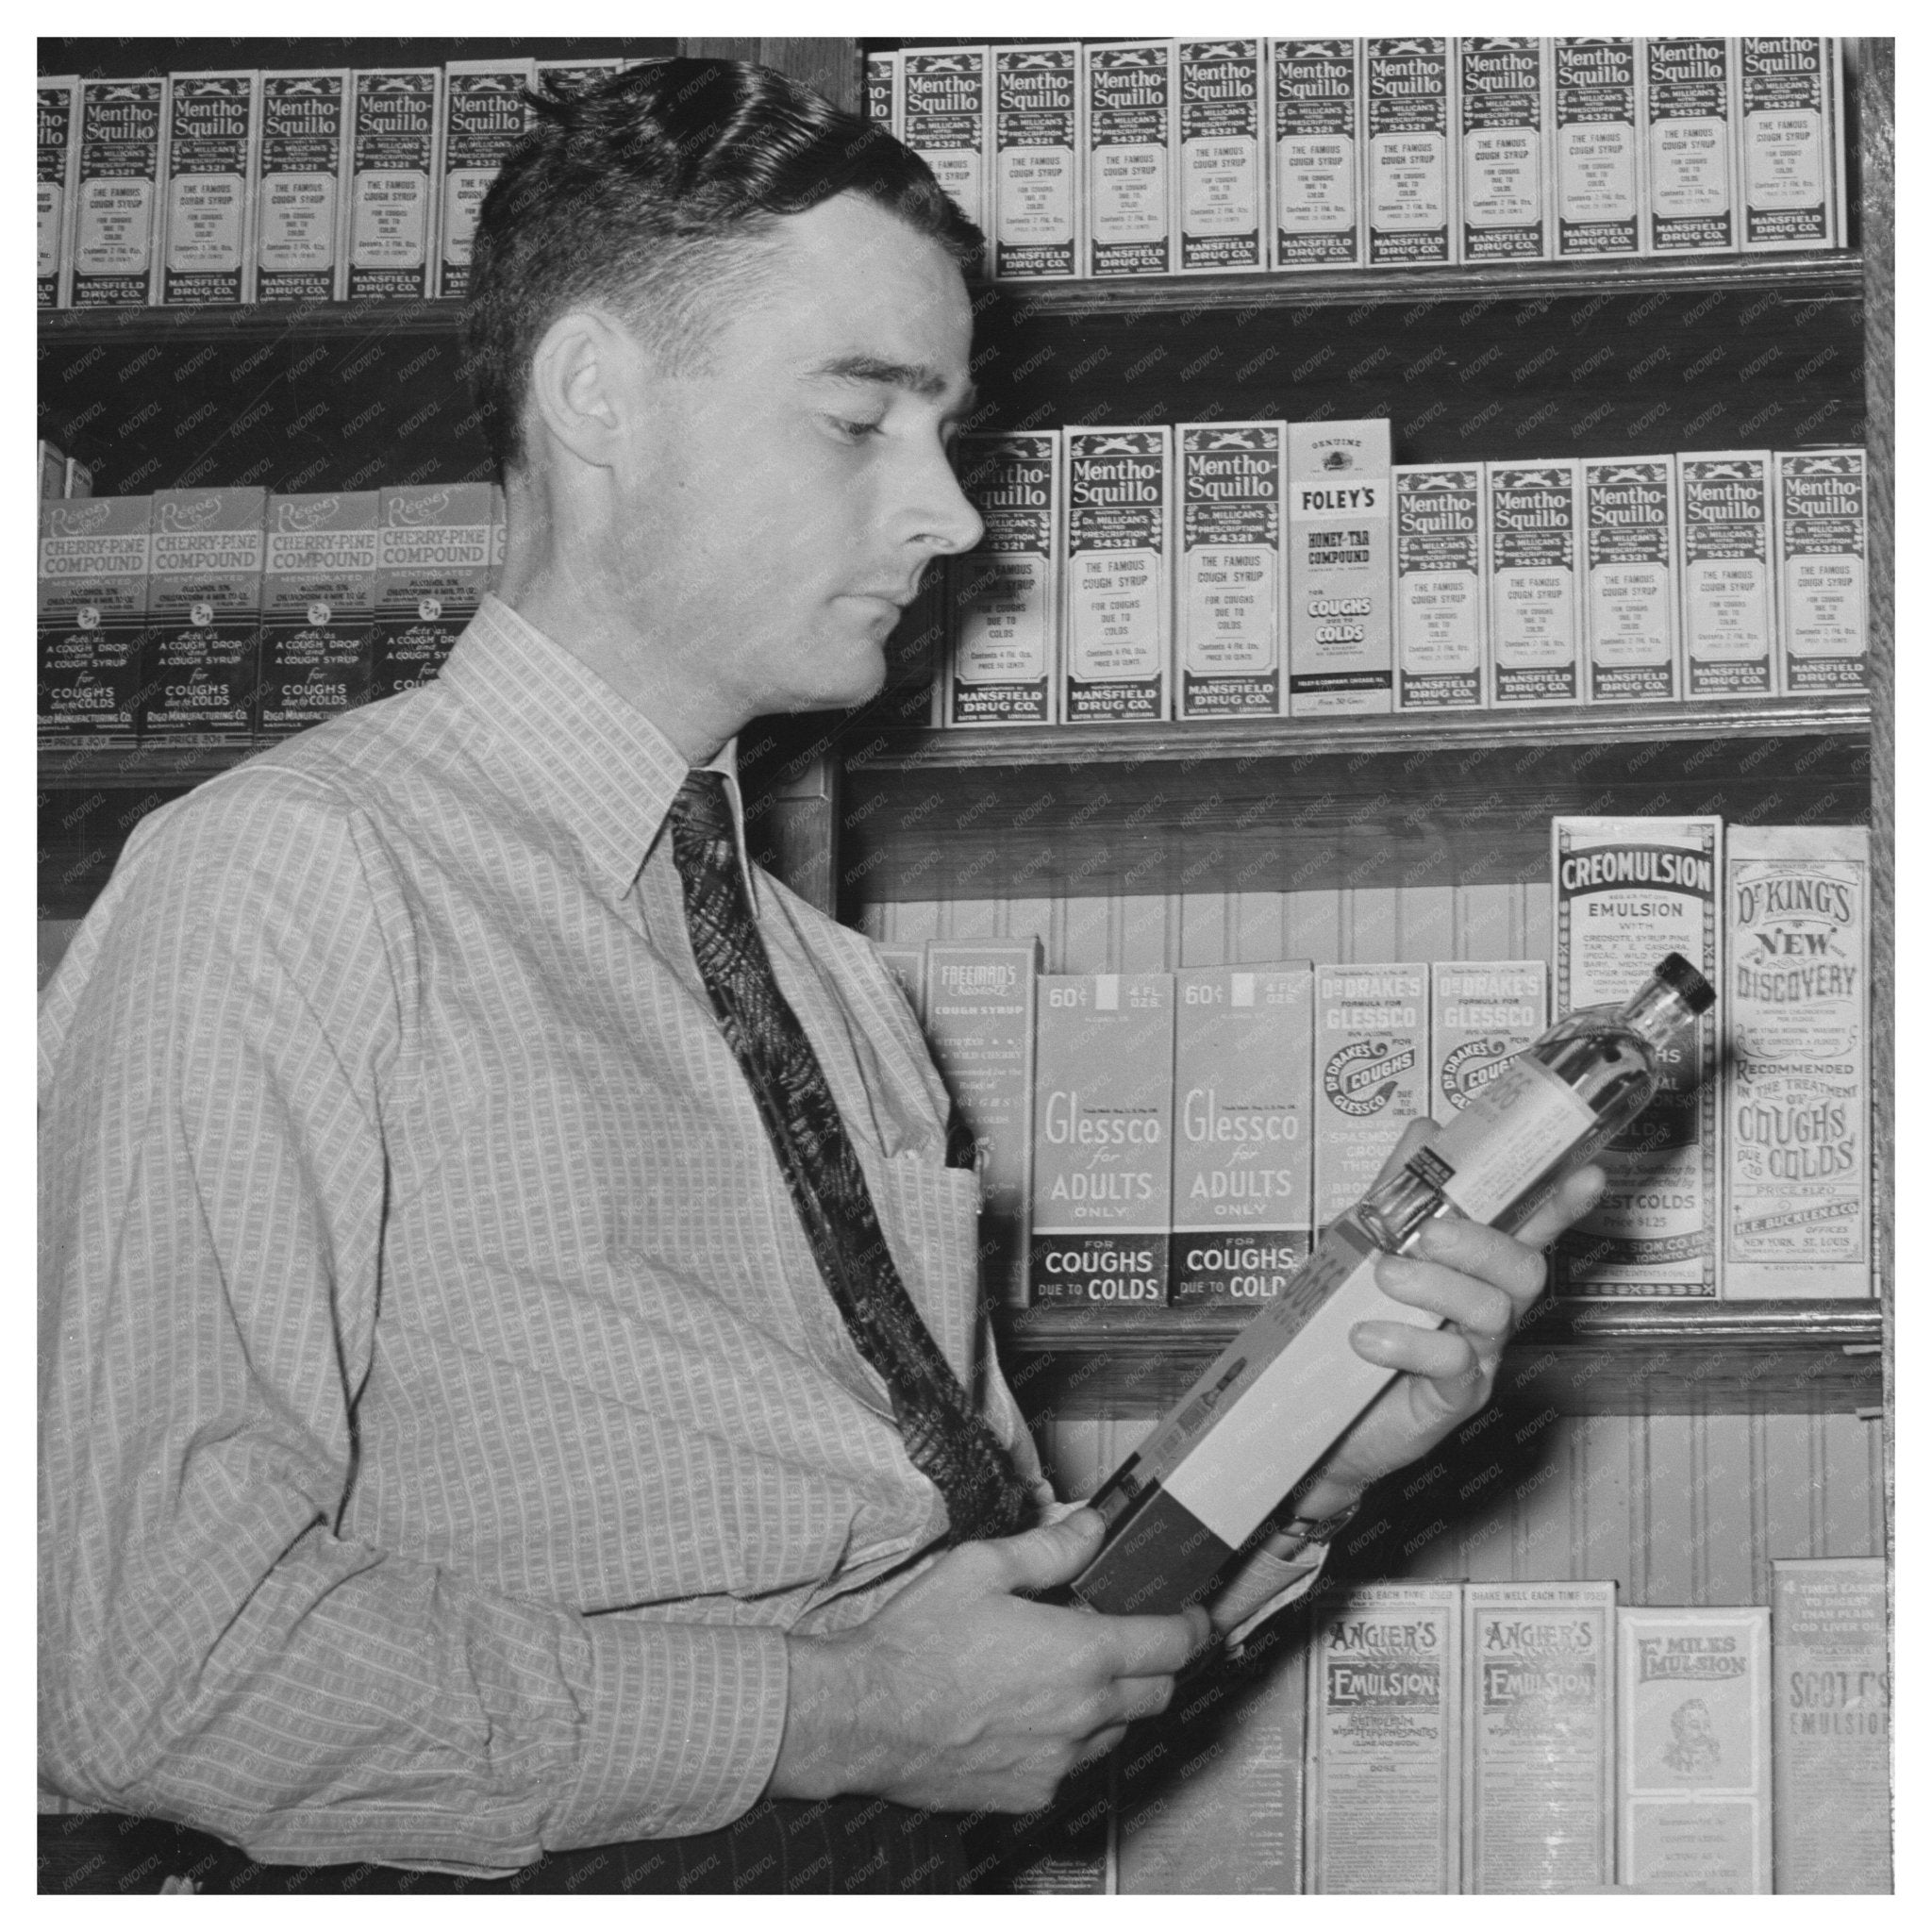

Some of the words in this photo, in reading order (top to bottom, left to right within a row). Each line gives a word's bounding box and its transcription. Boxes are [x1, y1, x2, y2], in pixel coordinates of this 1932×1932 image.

[1652, 46, 1724, 63] Mentho-
[1744, 38, 1818, 55] Mentho-
[1184, 63, 1257, 82] Mentho-
[1279, 62, 1352, 81] Mentho-
[1465, 56, 1539, 74] Mentho-
[1651, 62, 1722, 83] Squillo
[1744, 55, 1817, 75] Squillo
[908, 75, 982, 94] Mentho-
[1001, 74, 1074, 92] Mentho-
[1184, 82, 1253, 102] Squillo
[1279, 81, 1349, 99] Squillo
[1465, 73, 1535, 93] Squillo
[267, 97, 341, 116] Mentho-
[359, 95, 432, 114] Mentho-
[452, 95, 524, 113] Mentho-
[908, 94, 978, 114] Squillo
[1000, 92, 1070, 112] Squillo
[87, 104, 158, 123] Mentho-
[88, 123, 154, 141] Squillo
[267, 117, 336, 137] Squillo
[359, 114, 427, 135] Squillo
[451, 114, 520, 133] Squillo
[1001, 251, 1070, 260] MANSFIELD
[1007, 259, 1043, 269] DRUG
[1074, 459, 1160, 481] Mentho-
[1189, 455, 1276, 475] Mentho-
[1073, 481, 1158, 506] Squillo
[1188, 475, 1274, 500] Squillo
[1591, 487, 1666, 505] Mentho-
[1688, 483, 1762, 501] Mentho-
[1786, 478, 1860, 496] Mentho-
[1302, 487, 1374, 510] FOLEY'S
[1400, 493, 1475, 512] Mentho-
[1495, 491, 1571, 509] Mentho-
[1787, 497, 1858, 517] Squillo
[1495, 509, 1569, 530] Squillo
[1591, 505, 1664, 525] Squillo
[1689, 501, 1760, 522] Squillo
[1401, 512, 1474, 533] Squillo
[46, 539, 144, 556] CHERRY-PINE
[157, 535, 256, 551] CHERRY-PINE
[273, 534, 375, 551] CHERRY-PINE
[46, 557, 142, 573] COMPOUND
[156, 552, 255, 569] COMPOUND
[273, 552, 375, 568] COMPOUND
[1307, 549, 1370, 564] COMPOUND
[1086, 562, 1102, 573] THE
[1108, 560, 1145, 571] FAMOUS
[1082, 578, 1112, 589] COUGH
[1119, 575, 1148, 586] SYRUP
[1307, 598, 1371, 618] COUGHS
[1315, 625, 1364, 644] COLDS
[169, 641, 206, 650] COUGH
[189, 668, 208, 684] for
[51, 688, 113, 698] COUGHS
[165, 685, 229, 695] COUGHS
[1072, 690, 1157, 700] MANSFIELD
[1189, 684, 1274, 694] MANSFIELD
[77, 699, 114, 708] COLDS
[192, 696, 229, 706] COLDS
[1078, 701, 1124, 710] DRUG
[1195, 695, 1241, 705] DRUG
[1561, 852, 1710, 891] CREOMULSION
[1589, 903, 1682, 916] EMULSION
[1766, 879, 1849, 923] KING'S
[1754, 926, 1837, 960] NEW
[1344, 977, 1420, 997] DRAKE'S
[1737, 963, 1856, 1002] DISCOVERY
[1049, 989, 1087, 1008] 60¢
[1185, 986, 1223, 1005] 60¢
[1327, 1008, 1415, 1028] GLESSCO
[1444, 1007, 1534, 1027] GLESSCO
[1351, 1054, 1412, 1089] COUGHS
[1736, 1059, 1854, 1084] RECOMMENDED
[1785, 1079, 1857, 1097] TREATMENT
[1334, 1095, 1386, 1113] GLESSCO
[1046, 1091, 1160, 1143] Glessco
[1184, 1089, 1299, 1141] Glessco
[1738, 1104, 1845, 1147] COUGHS
[1086, 1146, 1120, 1169] for
[1225, 1143, 1258, 1167] for
[1769, 1134, 1855, 1180] COLDS
[1051, 1173, 1151, 1200] ADULTS
[1190, 1171, 1291, 1198] ADULTS
[1214, 1205, 1266, 1215] ONLY
[1638, 1195, 1695, 1208] COLDS
[1075, 1208, 1125, 1217] ONLY
[1821, 1237, 1849, 1246] LOUIS
[1046, 1252, 1152, 1273] COUGHS
[1187, 1249, 1293, 1271] COUGHS
[1039, 1285, 1062, 1295] DUE
[1068, 1285, 1083, 1295] TO
[1089, 1279, 1158, 1300] COLDS
[1180, 1283, 1204, 1292] DUE
[1210, 1282, 1224, 1292] TO
[1504, 1591, 1525, 1600] WELL
[1531, 1591, 1554, 1600] EACH
[1329, 1622, 1437, 1651] ANGIER'S
[1486, 1622, 1591, 1651] ANGIER'S
[1335, 1670, 1436, 1699] EMULSION
[1491, 1670, 1595, 1699] EMULSION
